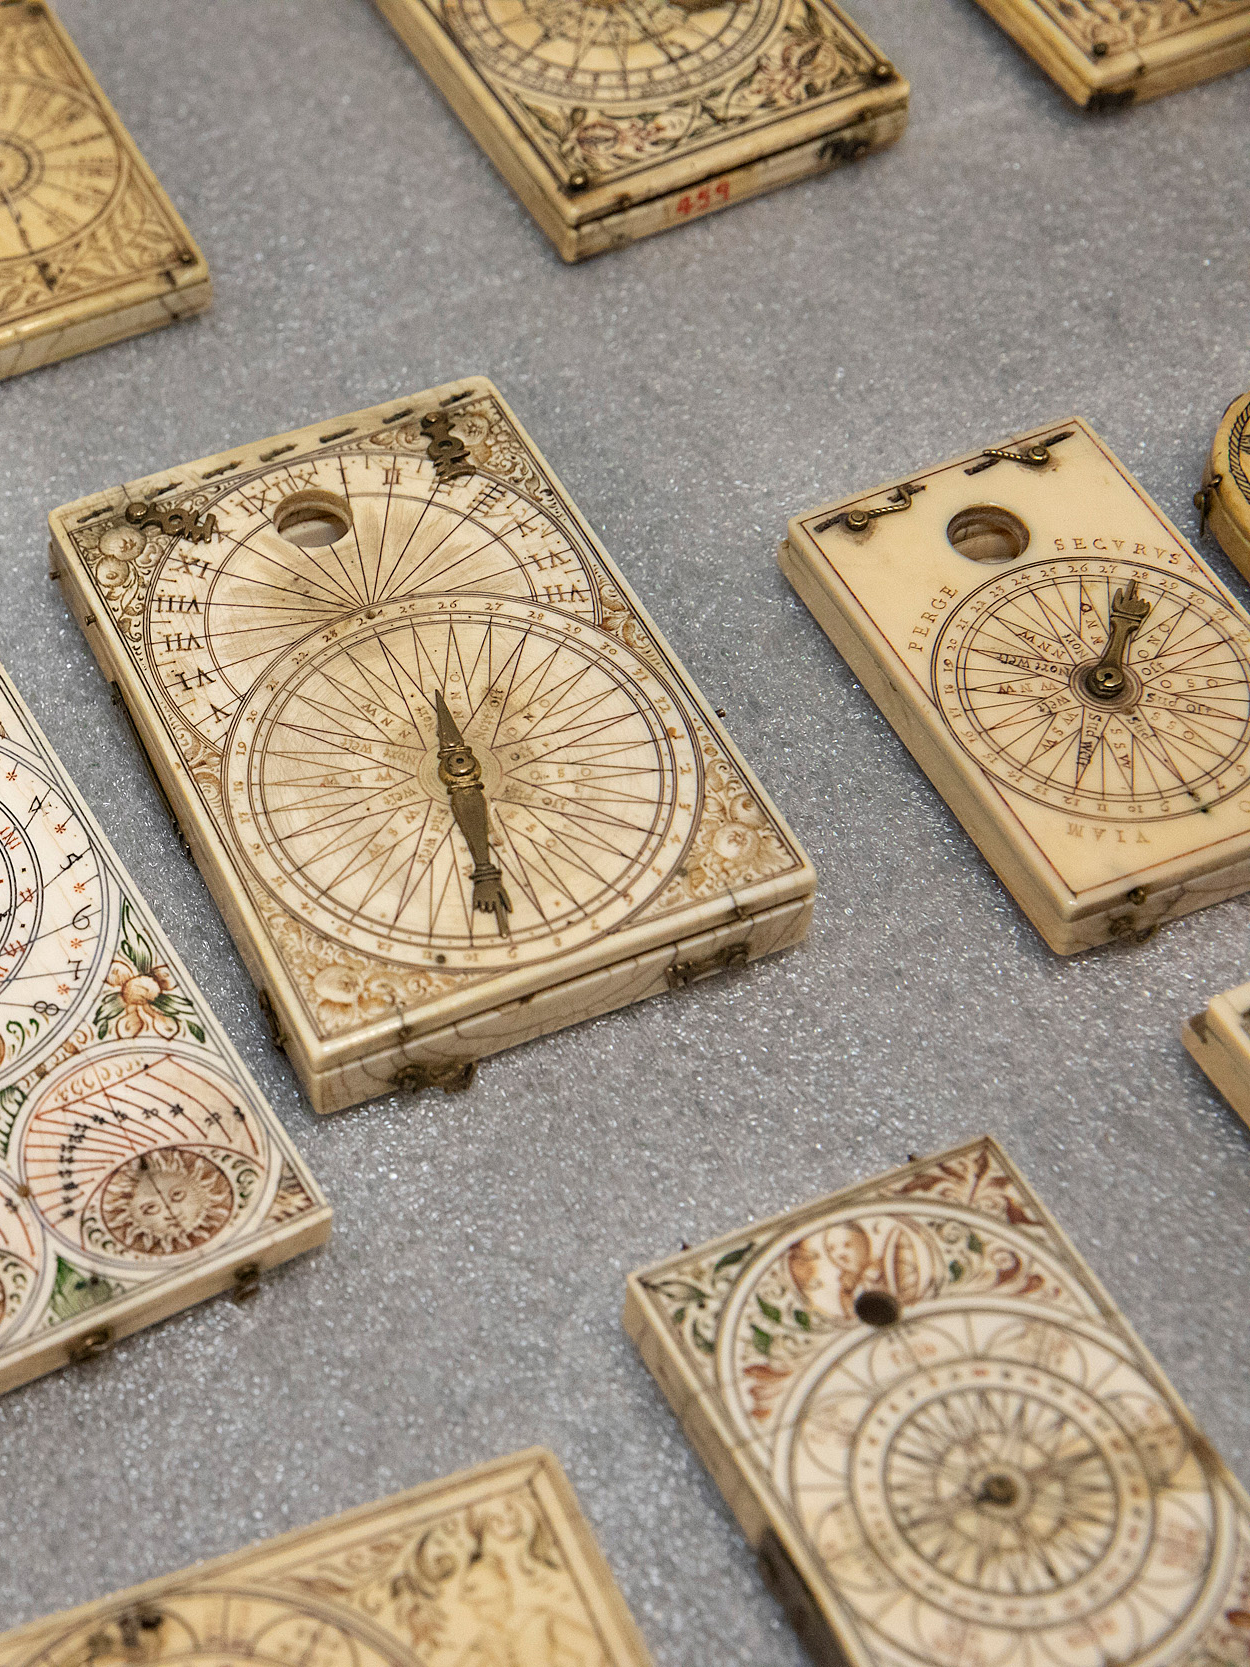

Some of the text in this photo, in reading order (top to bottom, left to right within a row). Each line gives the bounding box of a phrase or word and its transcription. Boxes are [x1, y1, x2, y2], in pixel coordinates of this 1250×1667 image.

[908, 537, 1183, 652] PERGE SECVRVS
[969, 600, 987, 613] 22
[988, 585, 1006, 599] 23
[1067, 563, 1089, 573] 26
[1131, 570, 1149, 580] 28
[1158, 578, 1179, 590] 29
[163, 628, 205, 652] VII
[542, 583, 590, 605] VII
[438, 599, 460, 610] 26
[1067, 821, 1151, 844] VIAM
[71, 904, 92, 930] 6
[33, 1000, 60, 1016] 8
